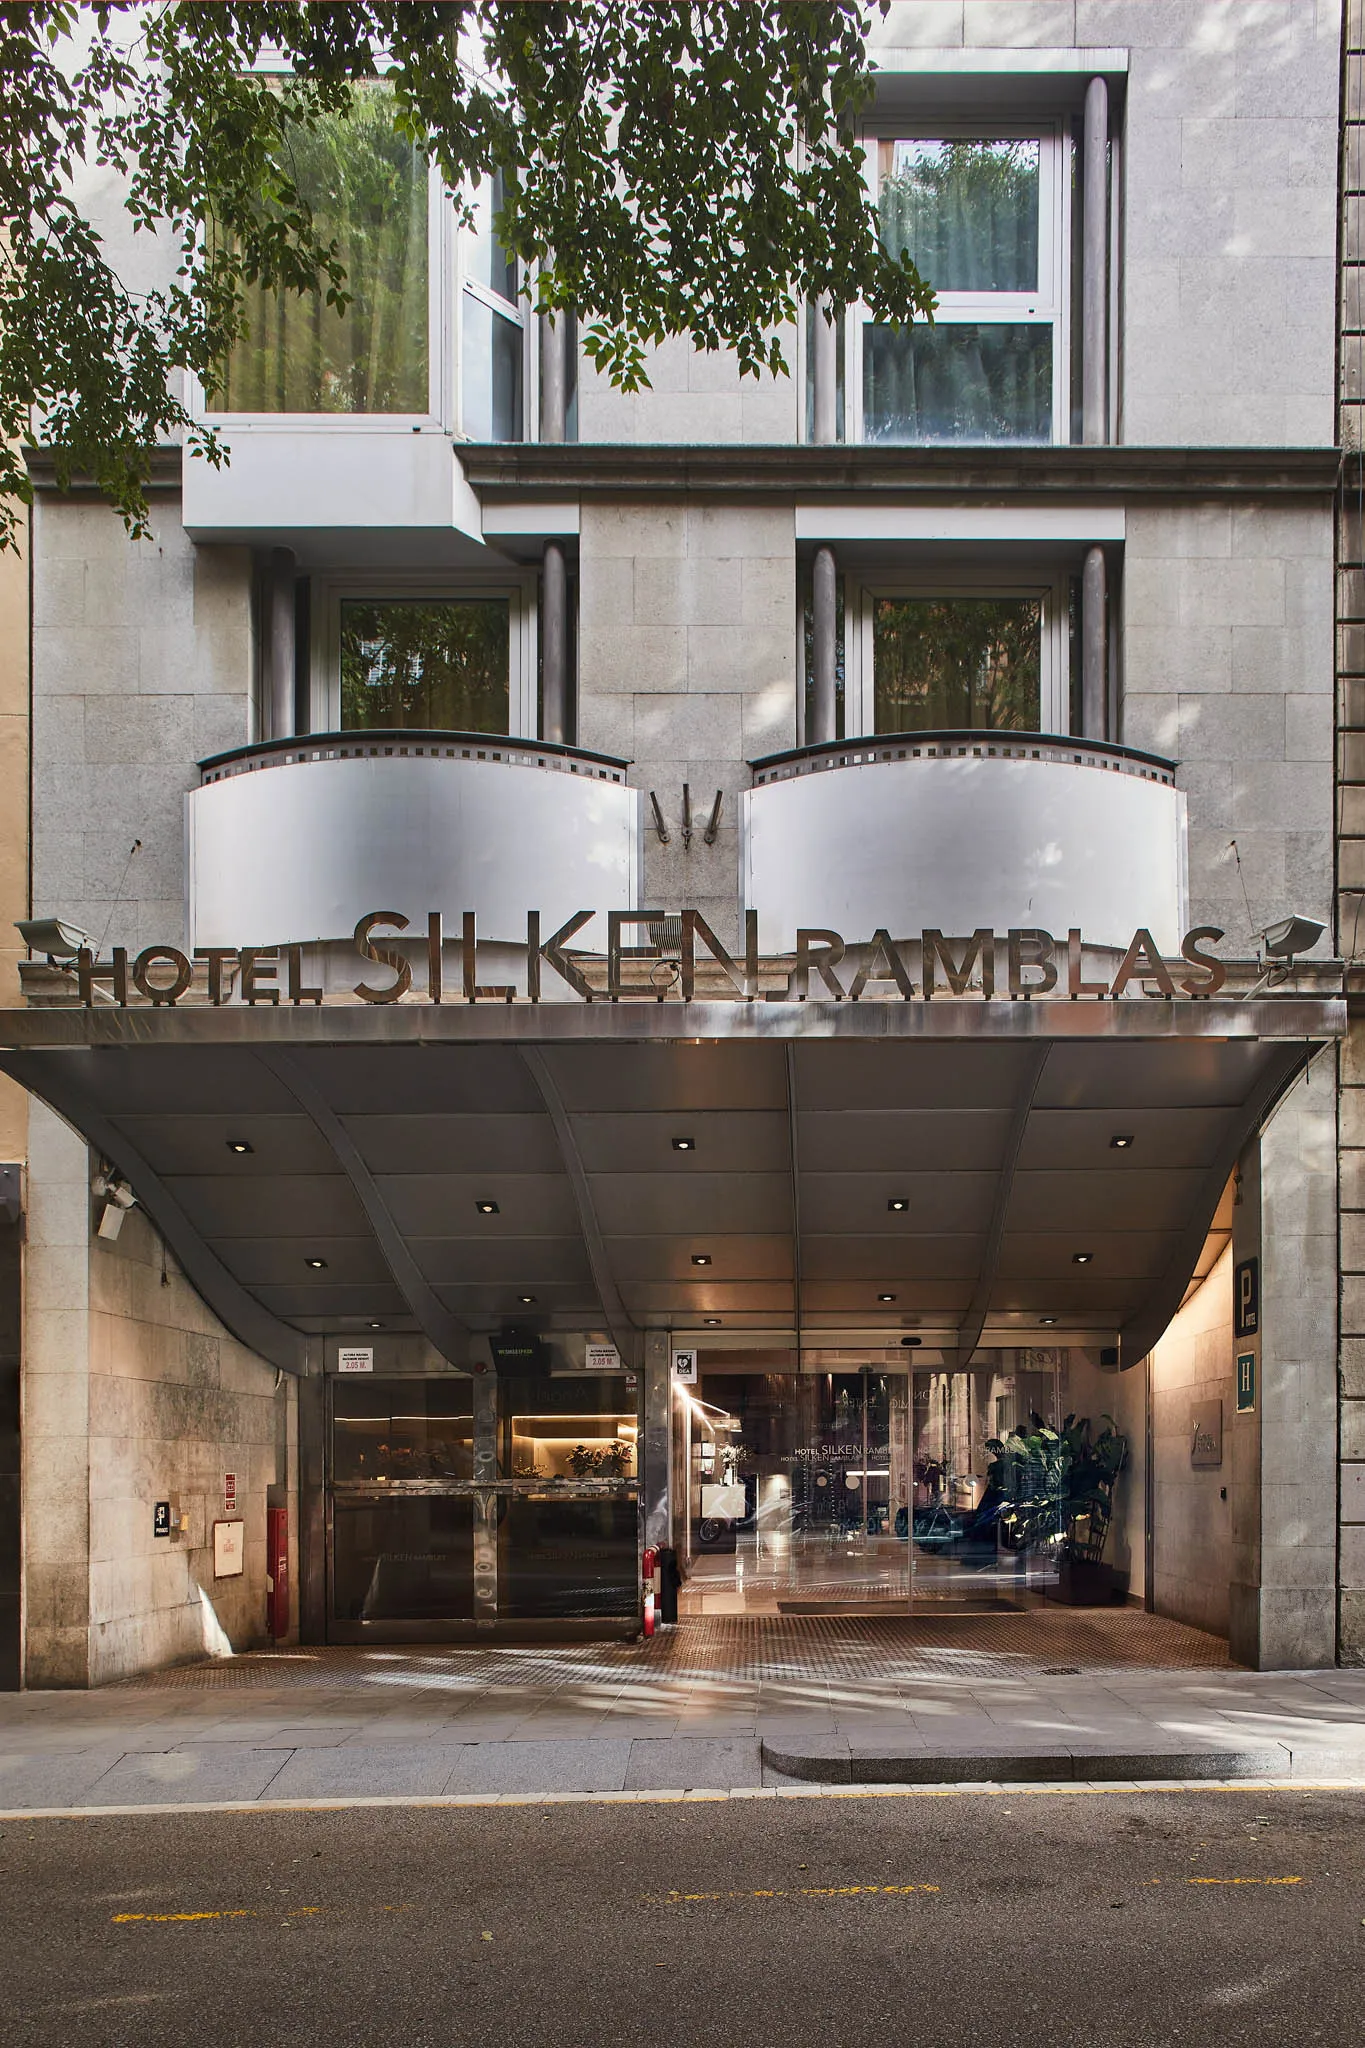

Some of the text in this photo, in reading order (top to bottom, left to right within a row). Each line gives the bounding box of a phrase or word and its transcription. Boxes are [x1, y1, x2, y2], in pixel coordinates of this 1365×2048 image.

[78, 909, 1226, 1003] HOTEL SILKEN RAMBLAS
[1241, 1269, 1251, 1328] P
[1241, 1362, 1251, 1392] H
[821, 1444, 862, 1455] SILKEN
